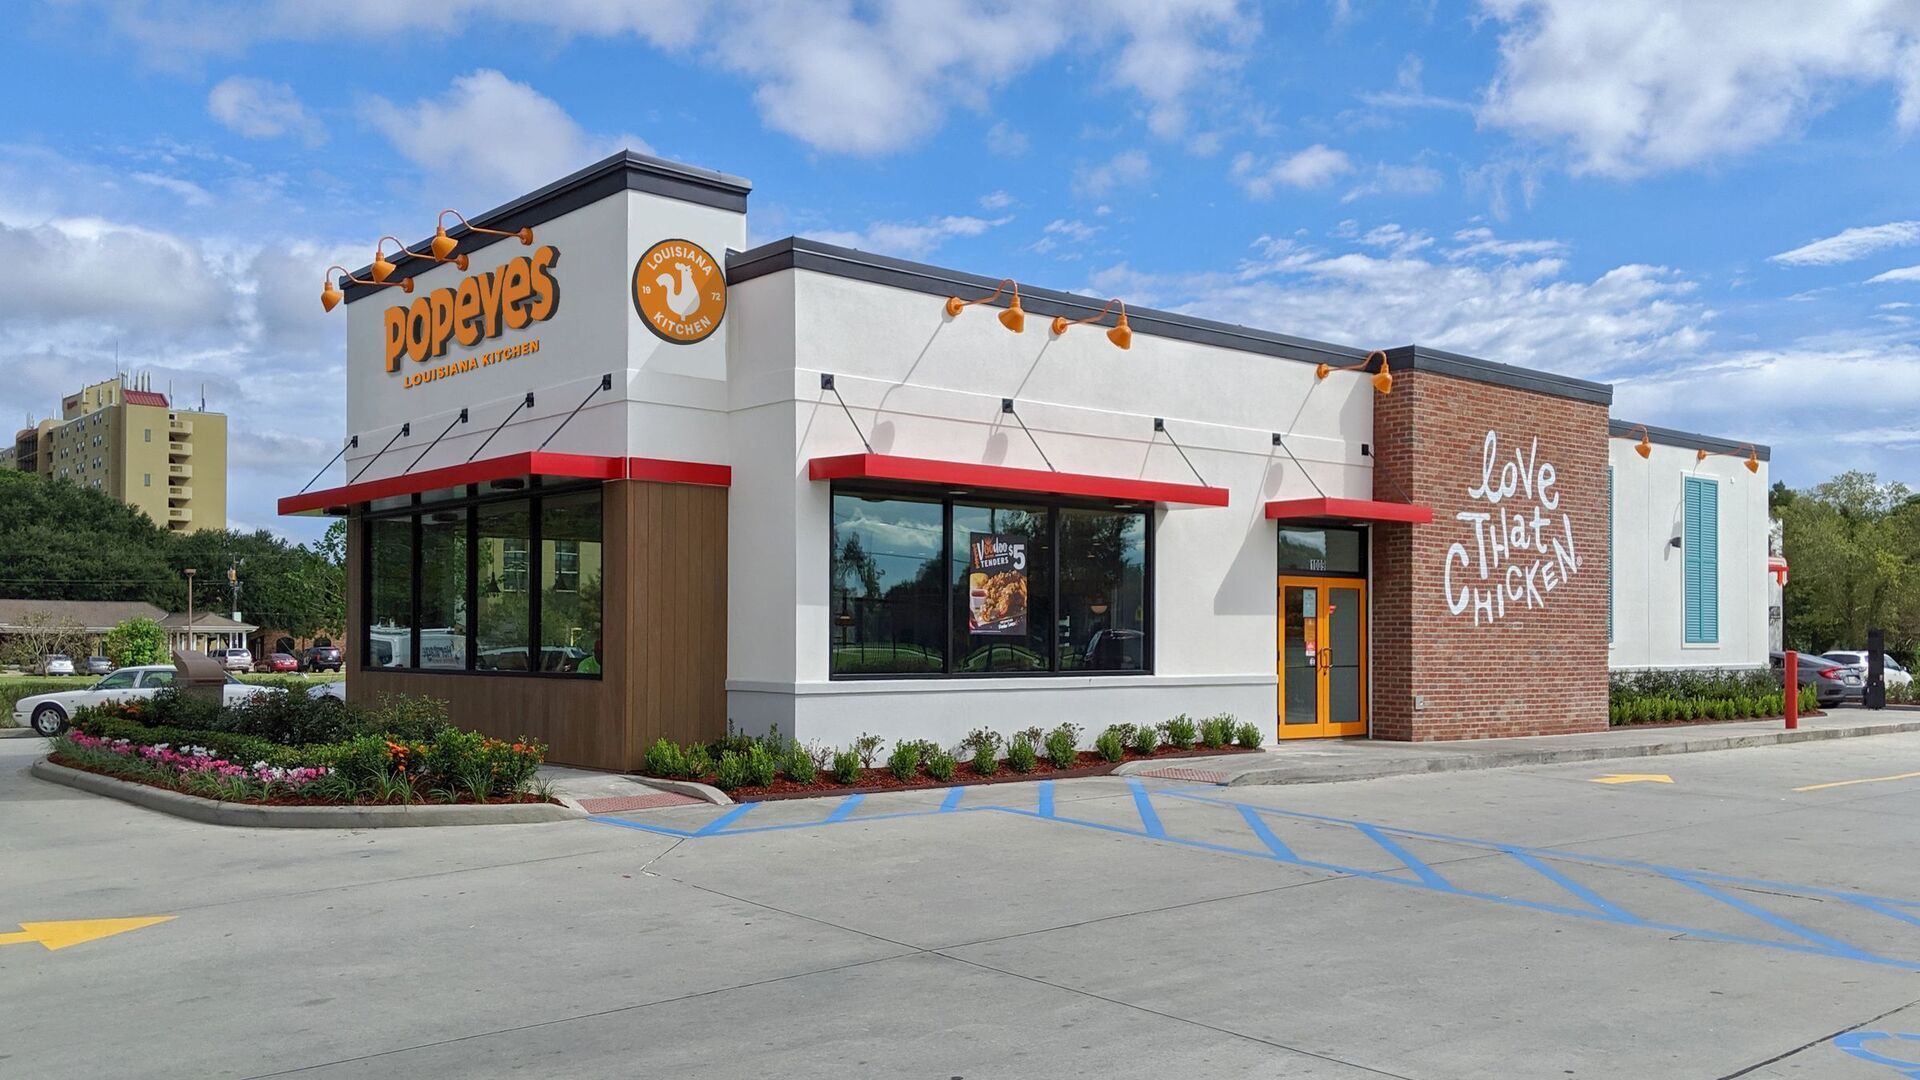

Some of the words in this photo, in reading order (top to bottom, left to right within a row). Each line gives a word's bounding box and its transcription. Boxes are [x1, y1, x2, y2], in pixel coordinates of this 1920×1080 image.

[647, 246, 713, 276] LOUISIANA
[642, 286, 652, 294] 19
[711, 292, 721, 301] 72
[653, 312, 712, 335] KITCHEN
[403, 358, 479, 388] LOUISIANA
[482, 340, 540, 366] KITCHEN
[981, 557, 1009, 568] TENDERS
